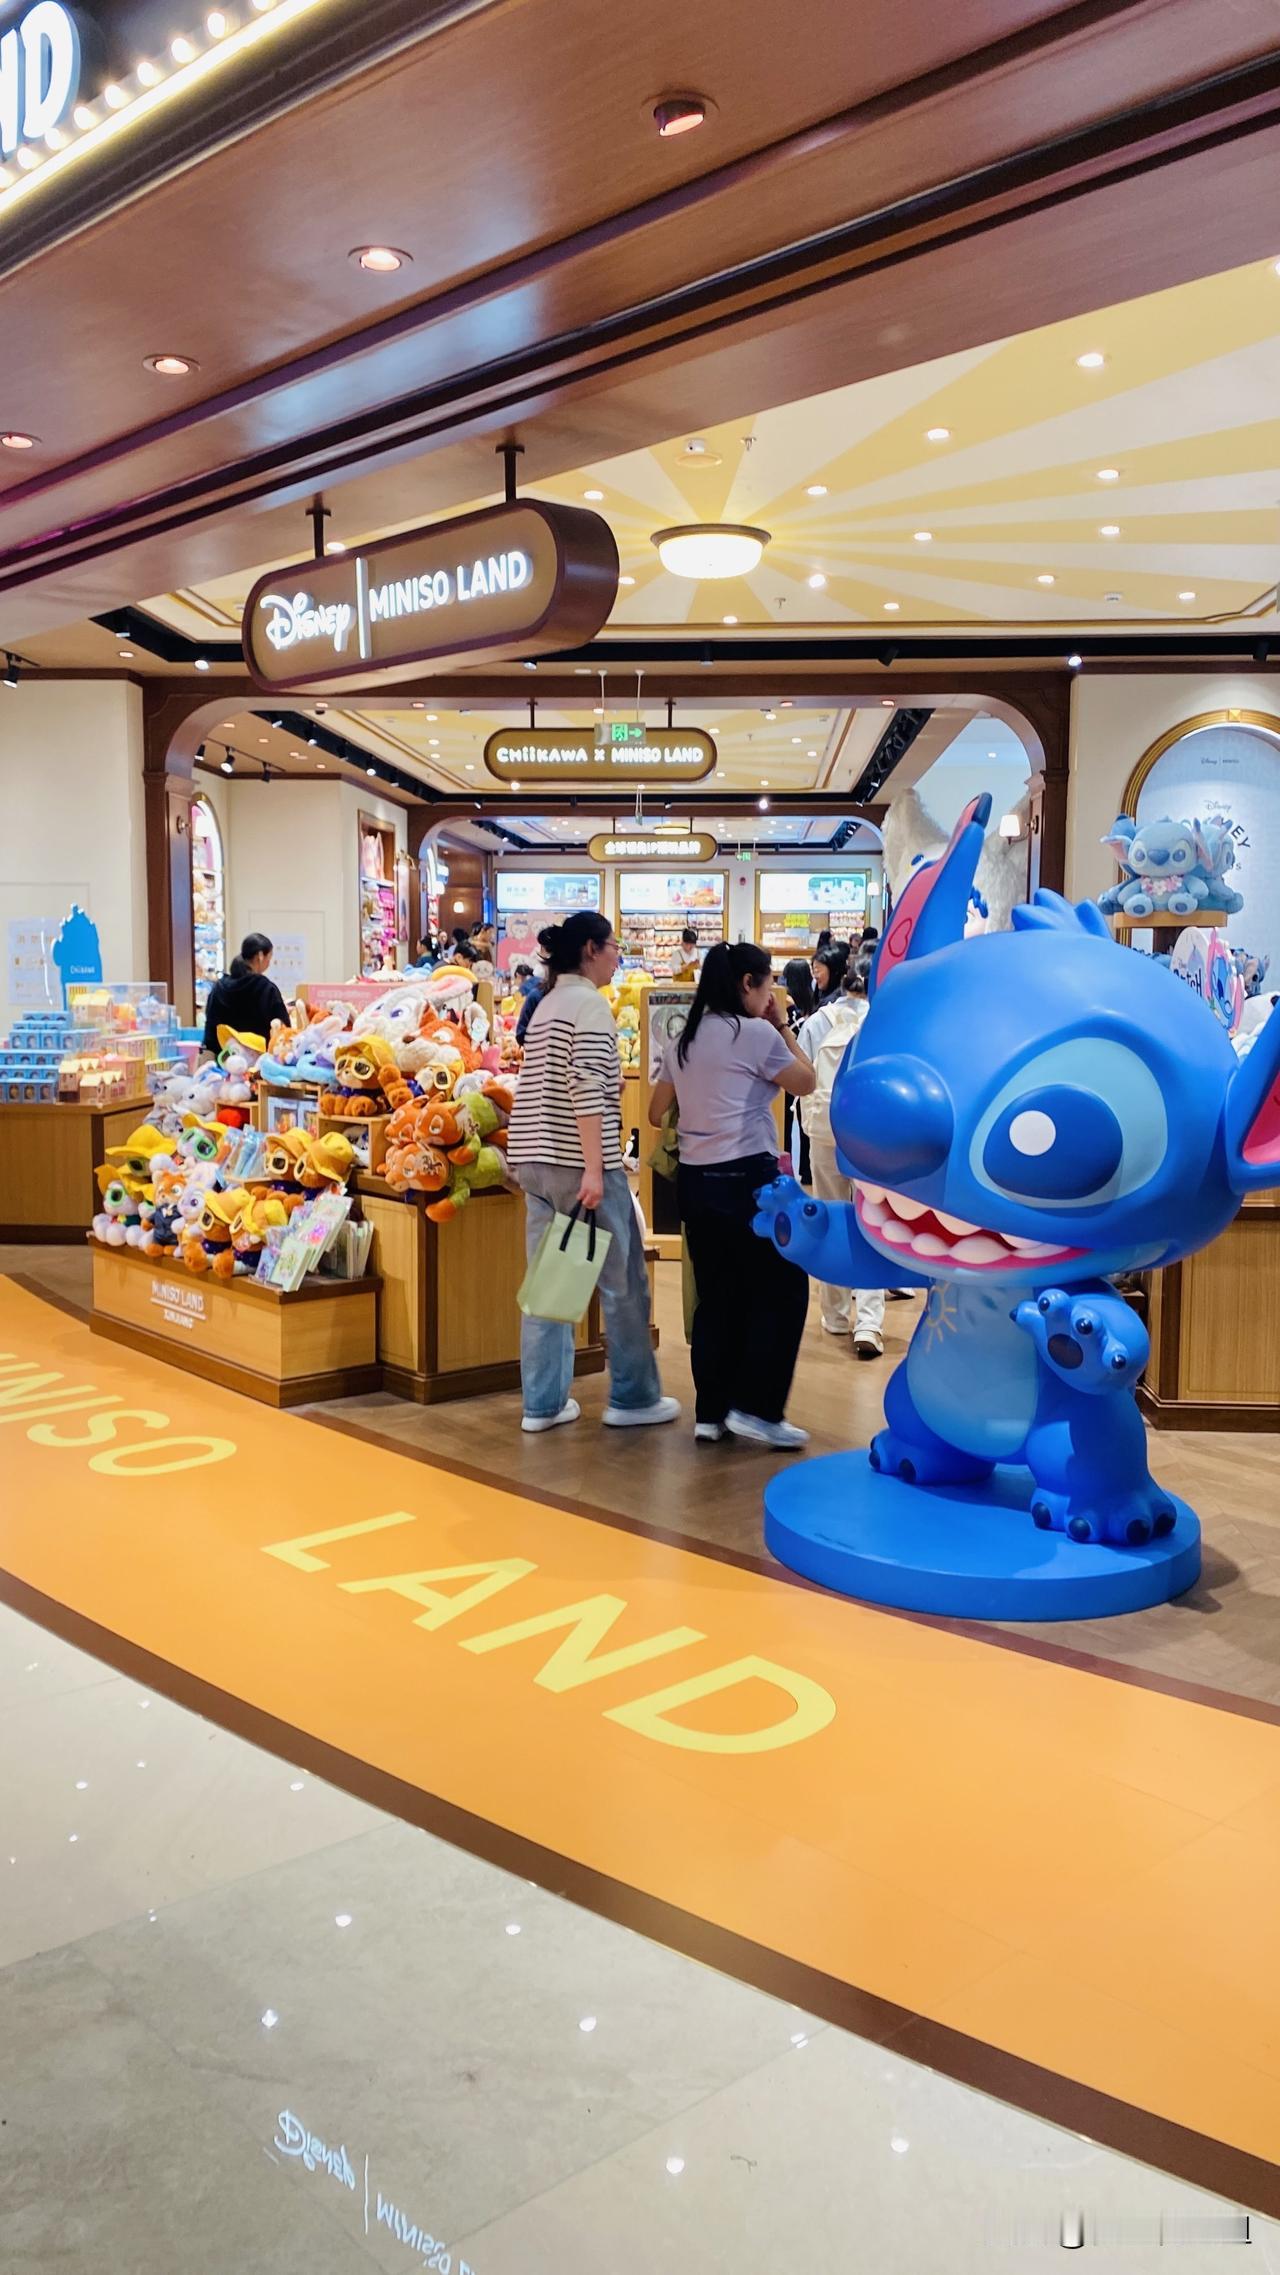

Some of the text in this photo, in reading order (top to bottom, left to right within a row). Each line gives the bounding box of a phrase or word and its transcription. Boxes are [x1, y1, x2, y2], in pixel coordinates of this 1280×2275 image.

[260, 551, 528, 652] Disney MINISO LAND
[610, 747, 662, 764] MINISO
[663, 747, 704, 764] LAND
[181, 1290, 204, 1312] LAND
[0, 1353, 838, 1754] NISO LAND
